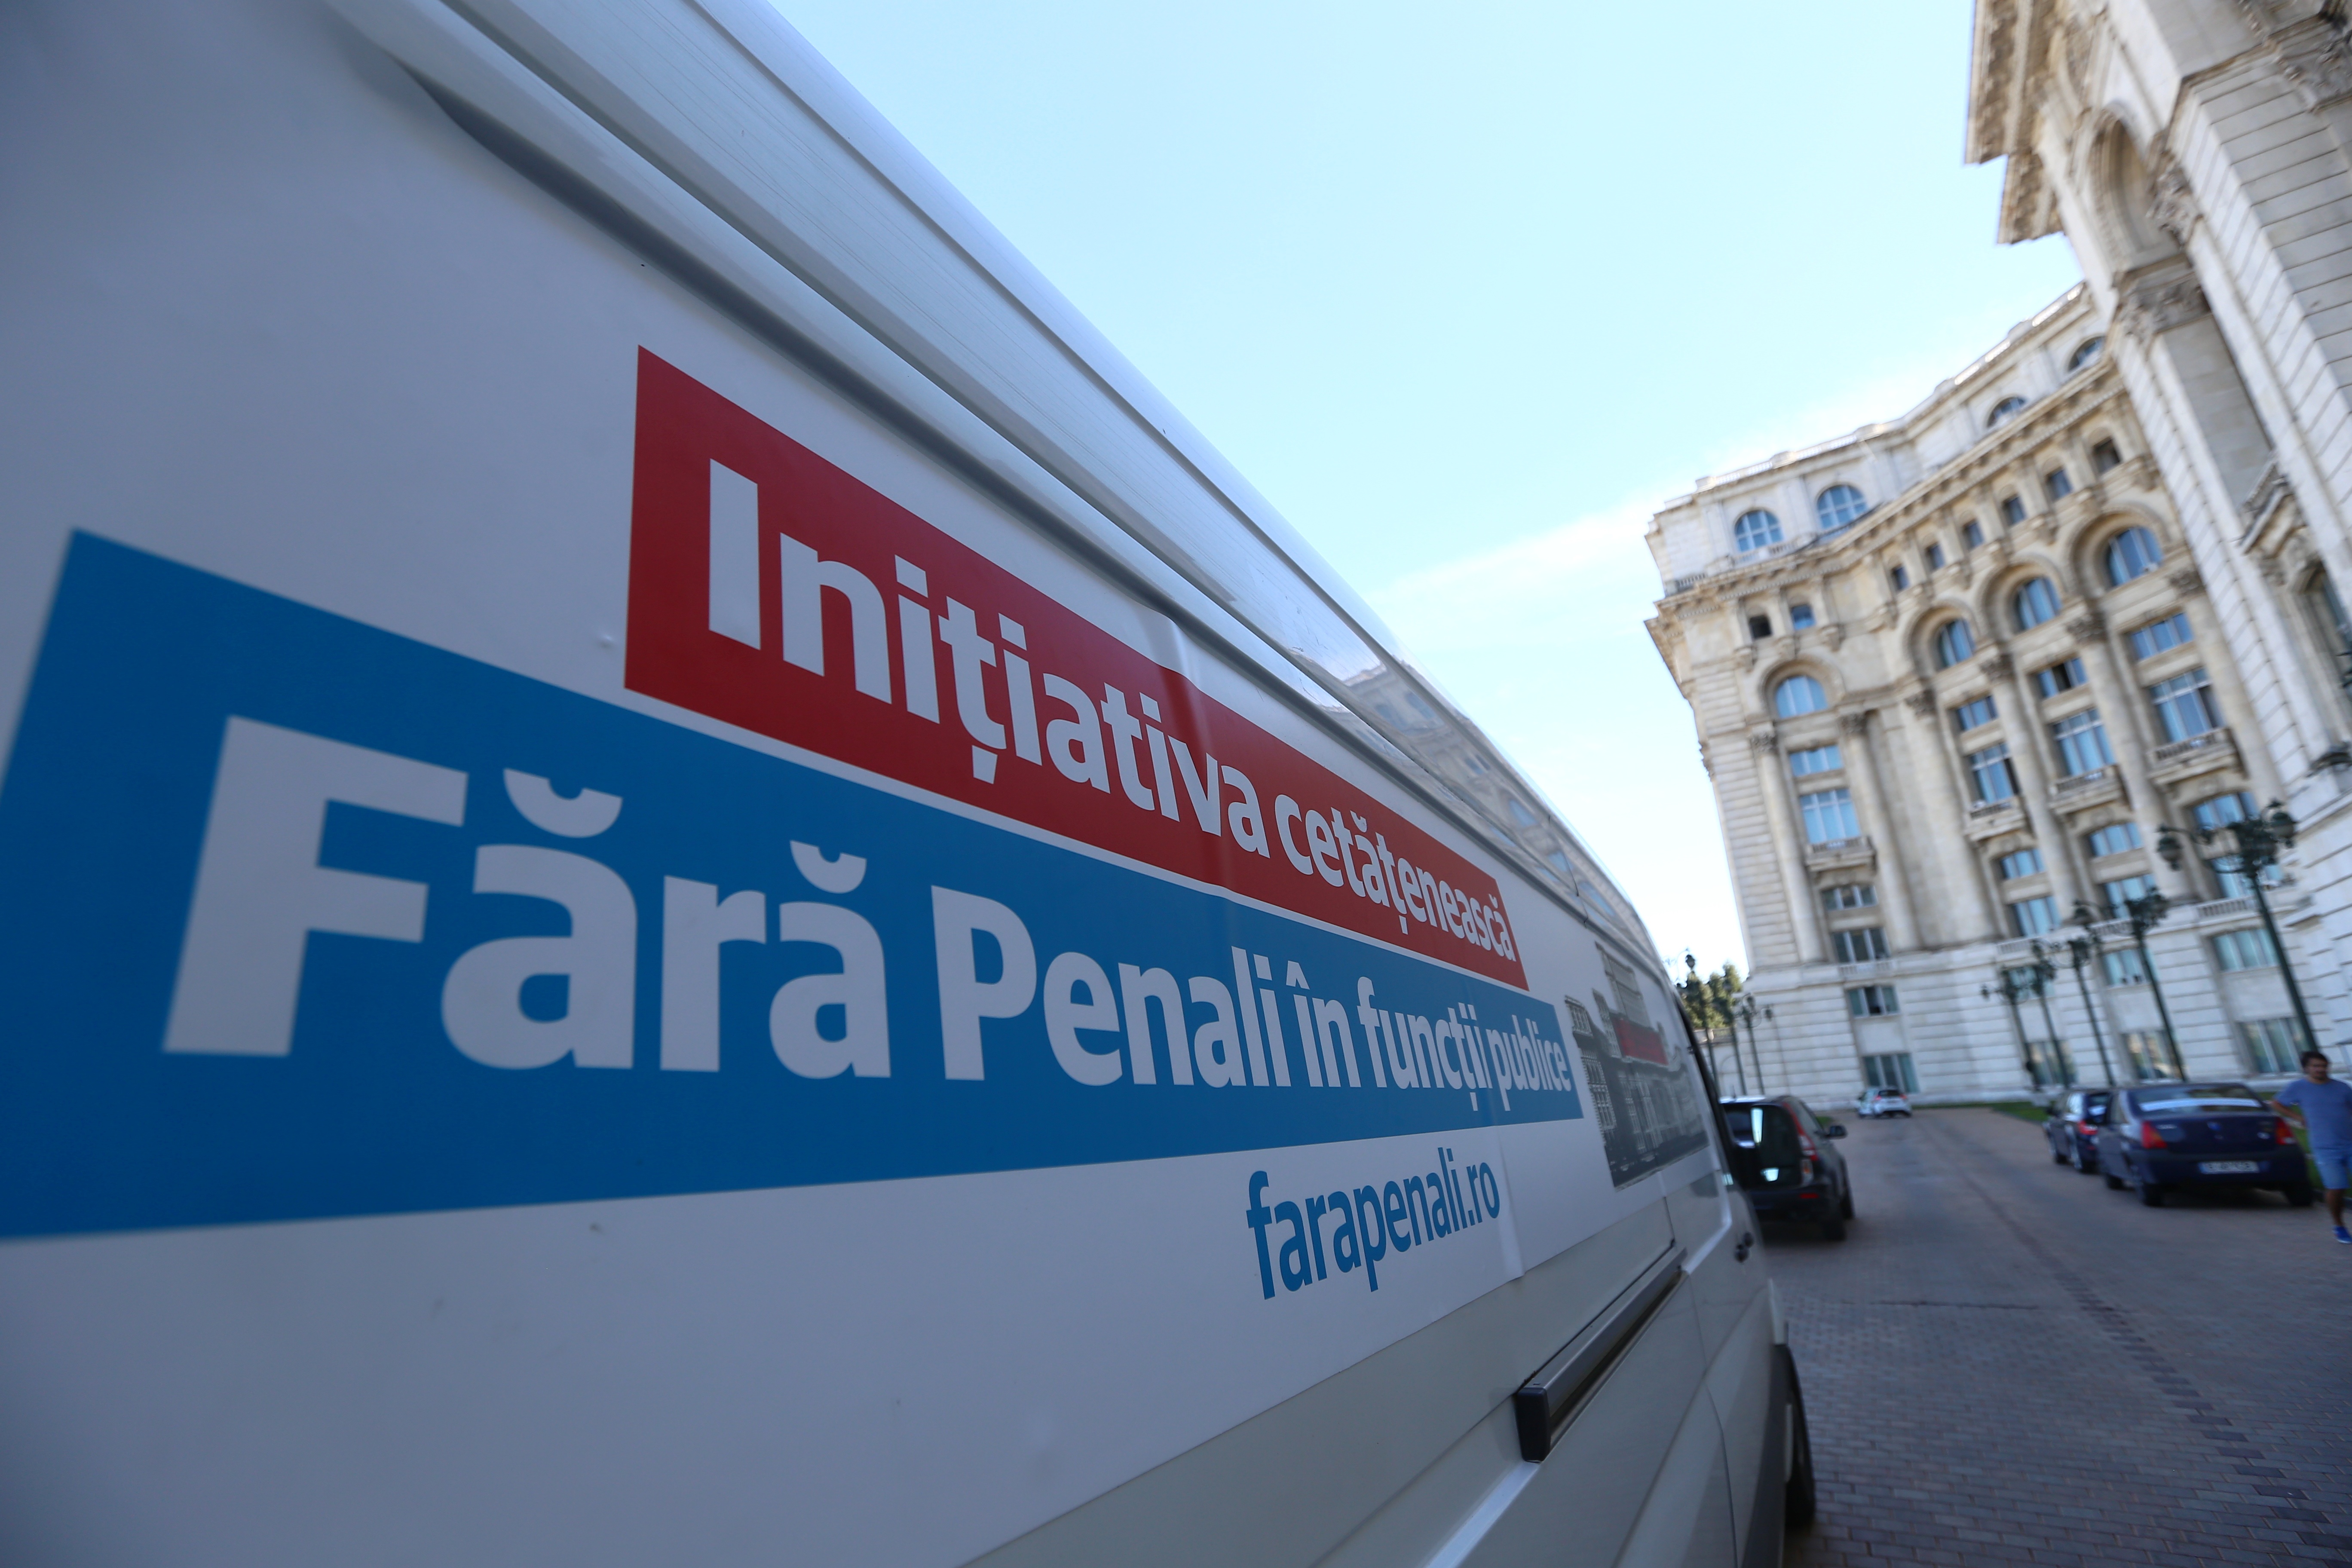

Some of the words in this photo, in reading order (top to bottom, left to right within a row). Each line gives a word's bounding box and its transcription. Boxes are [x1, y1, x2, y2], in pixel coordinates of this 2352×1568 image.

[709, 458, 1270, 859] Inițiativa
[1275, 794, 1516, 962] cetățenească
[163, 714, 891, 1079] Fără
[931, 885, 1291, 1088] Penali
[1286, 960, 1361, 1088] în
[1357, 976, 1492, 1111] funcții
[1487, 1015, 1571, 1111] publice
[1246, 1147, 1500, 1300] farapenali.ro
